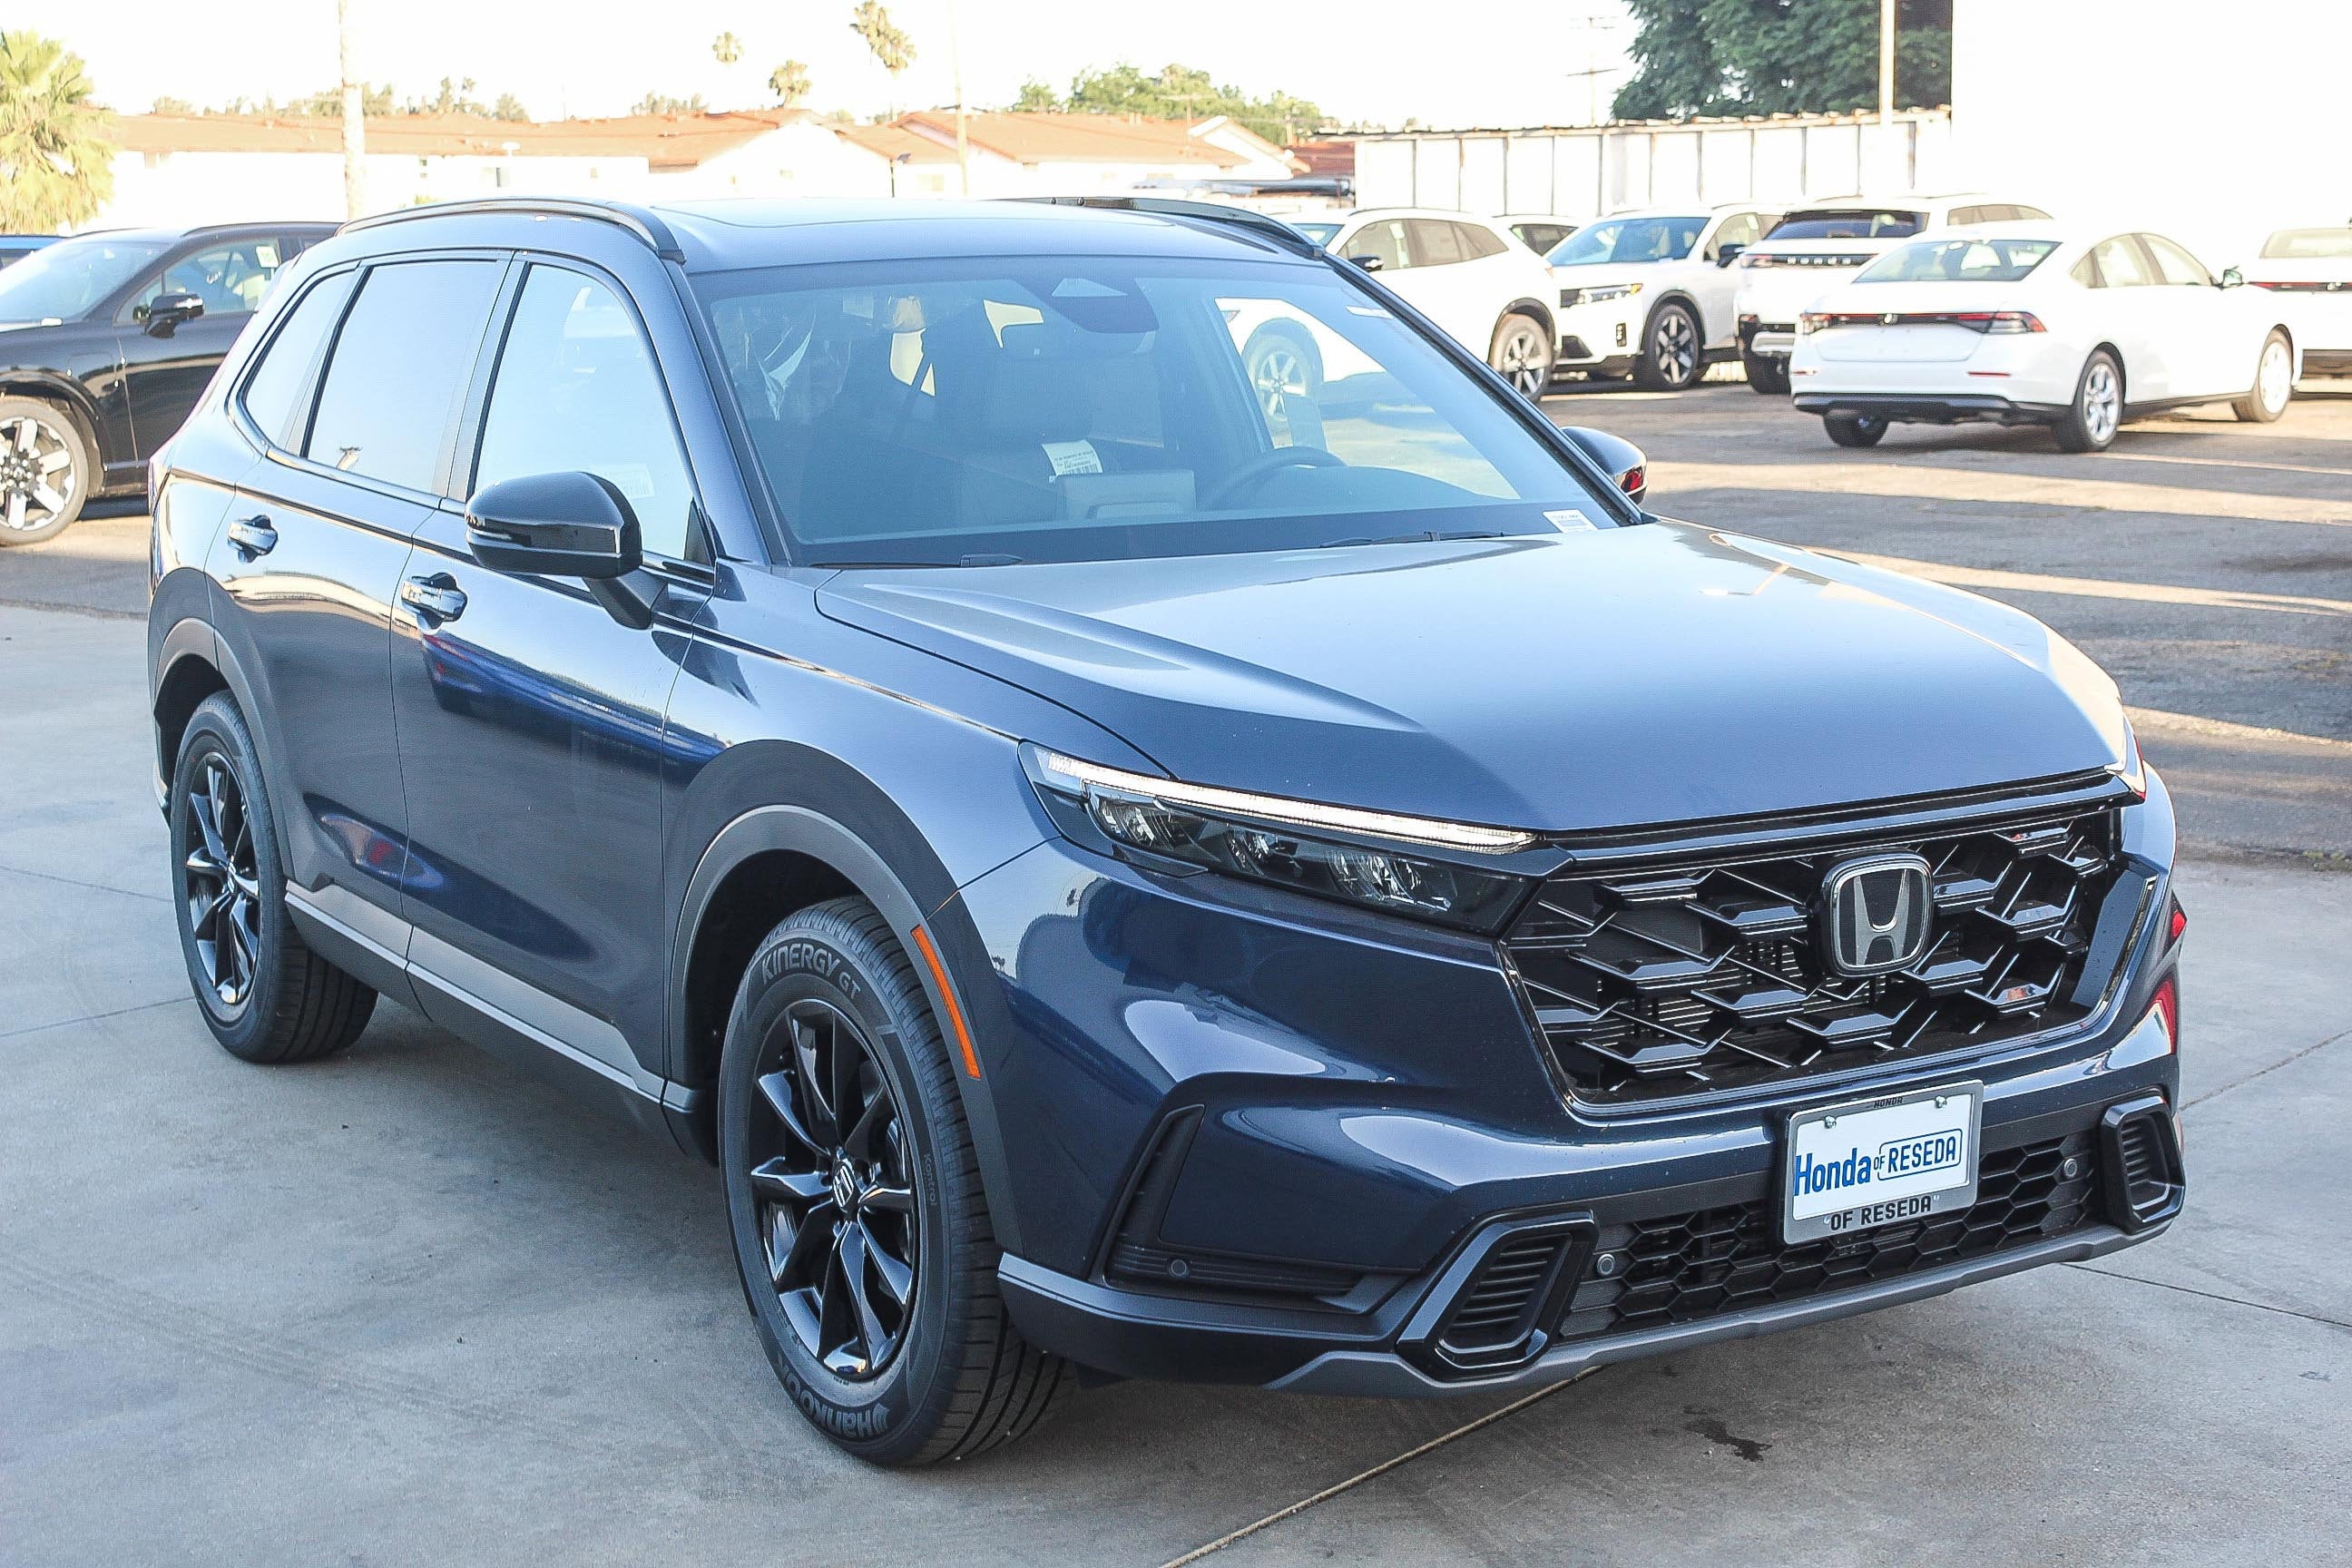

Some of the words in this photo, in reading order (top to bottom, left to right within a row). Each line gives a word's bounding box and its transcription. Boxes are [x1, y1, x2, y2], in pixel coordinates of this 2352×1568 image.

[761, 942, 841, 985] KINERGY
[838, 971, 863, 999] GT
[1873, 1096, 1903, 1108] HONDA
[1794, 1148, 1870, 1196] Honda
[1873, 1155, 1886, 1171] OF
[1887, 1136, 1956, 1173] RESEDA
[1830, 1210, 1853, 1231] OF
[1860, 1195, 1932, 1226] RESEDA
